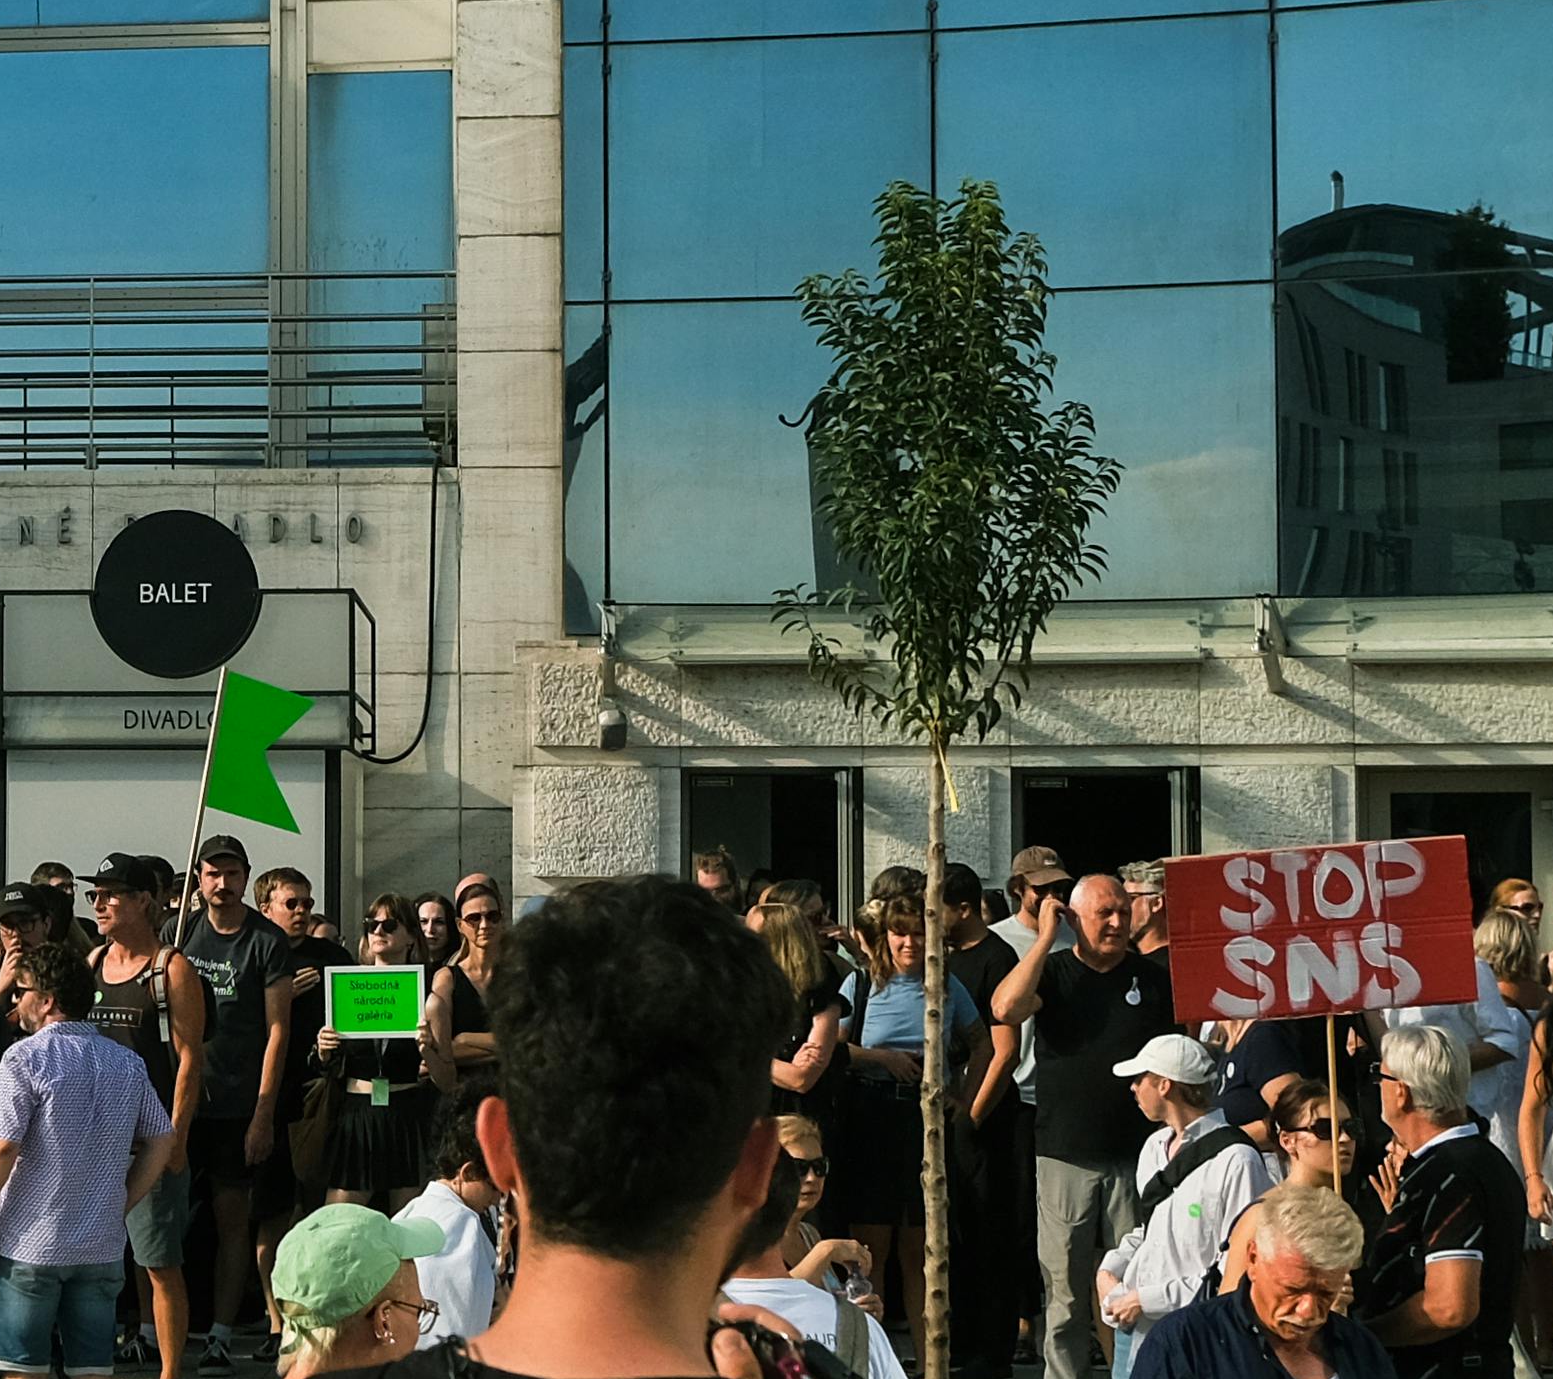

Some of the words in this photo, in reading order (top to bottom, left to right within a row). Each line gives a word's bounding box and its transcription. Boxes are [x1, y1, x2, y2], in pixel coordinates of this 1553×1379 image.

[139, 582, 212, 604] BALET
[1219, 840, 1426, 933] STOP
[1210, 921, 1422, 1020] SNS
[349, 980, 400, 990] Slobodná
[354, 996, 396, 1005] národná
[357, 1010, 394, 1023] galéria
